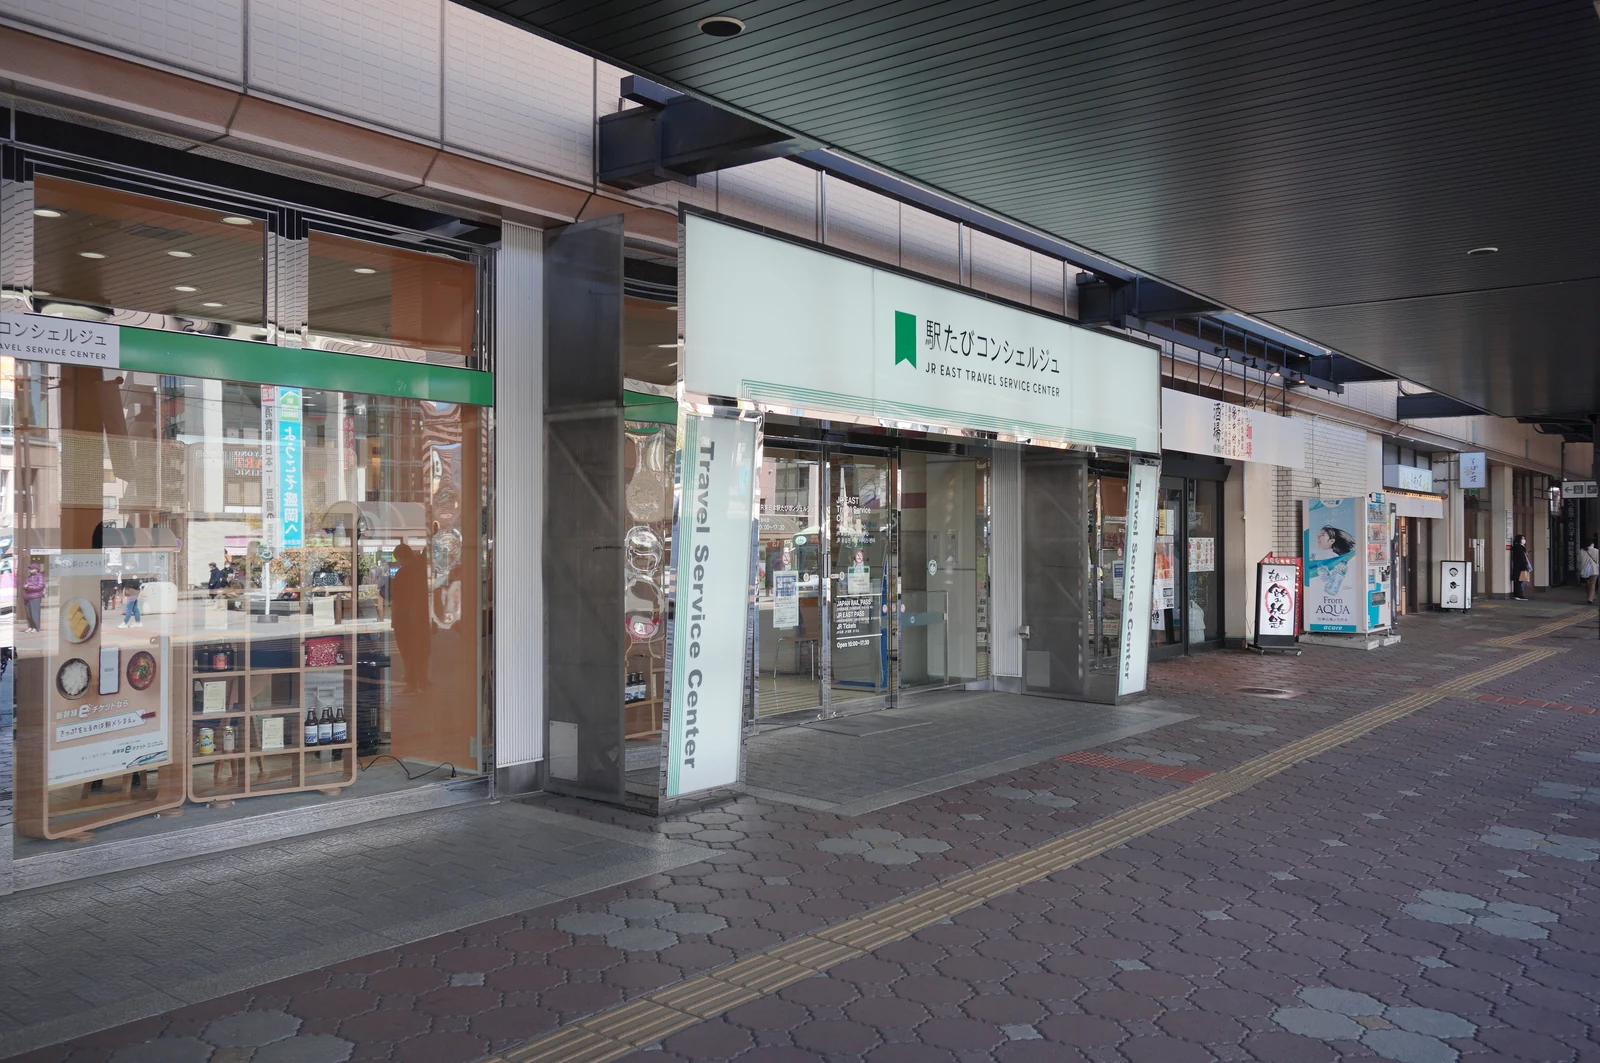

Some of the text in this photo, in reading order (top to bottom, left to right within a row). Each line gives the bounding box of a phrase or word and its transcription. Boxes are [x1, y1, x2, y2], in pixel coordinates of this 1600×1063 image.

[0, 322, 107, 346] コンシェルジュ
[924, 319, 1060, 374] 駅たびコンシェルジュ
[26, 345, 66, 356] SERVICE
[70, 350, 107, 360] CENTER
[925, 362, 1060, 397] JR EAST TRAVEL SERVICE CENTER
[1124, 479, 1142, 680] Travel Service Center
[684, 442, 715, 769] Travel Service Center
[1315, 604, 1351, 617] AQUA
[1323, 596, 1343, 604] From
